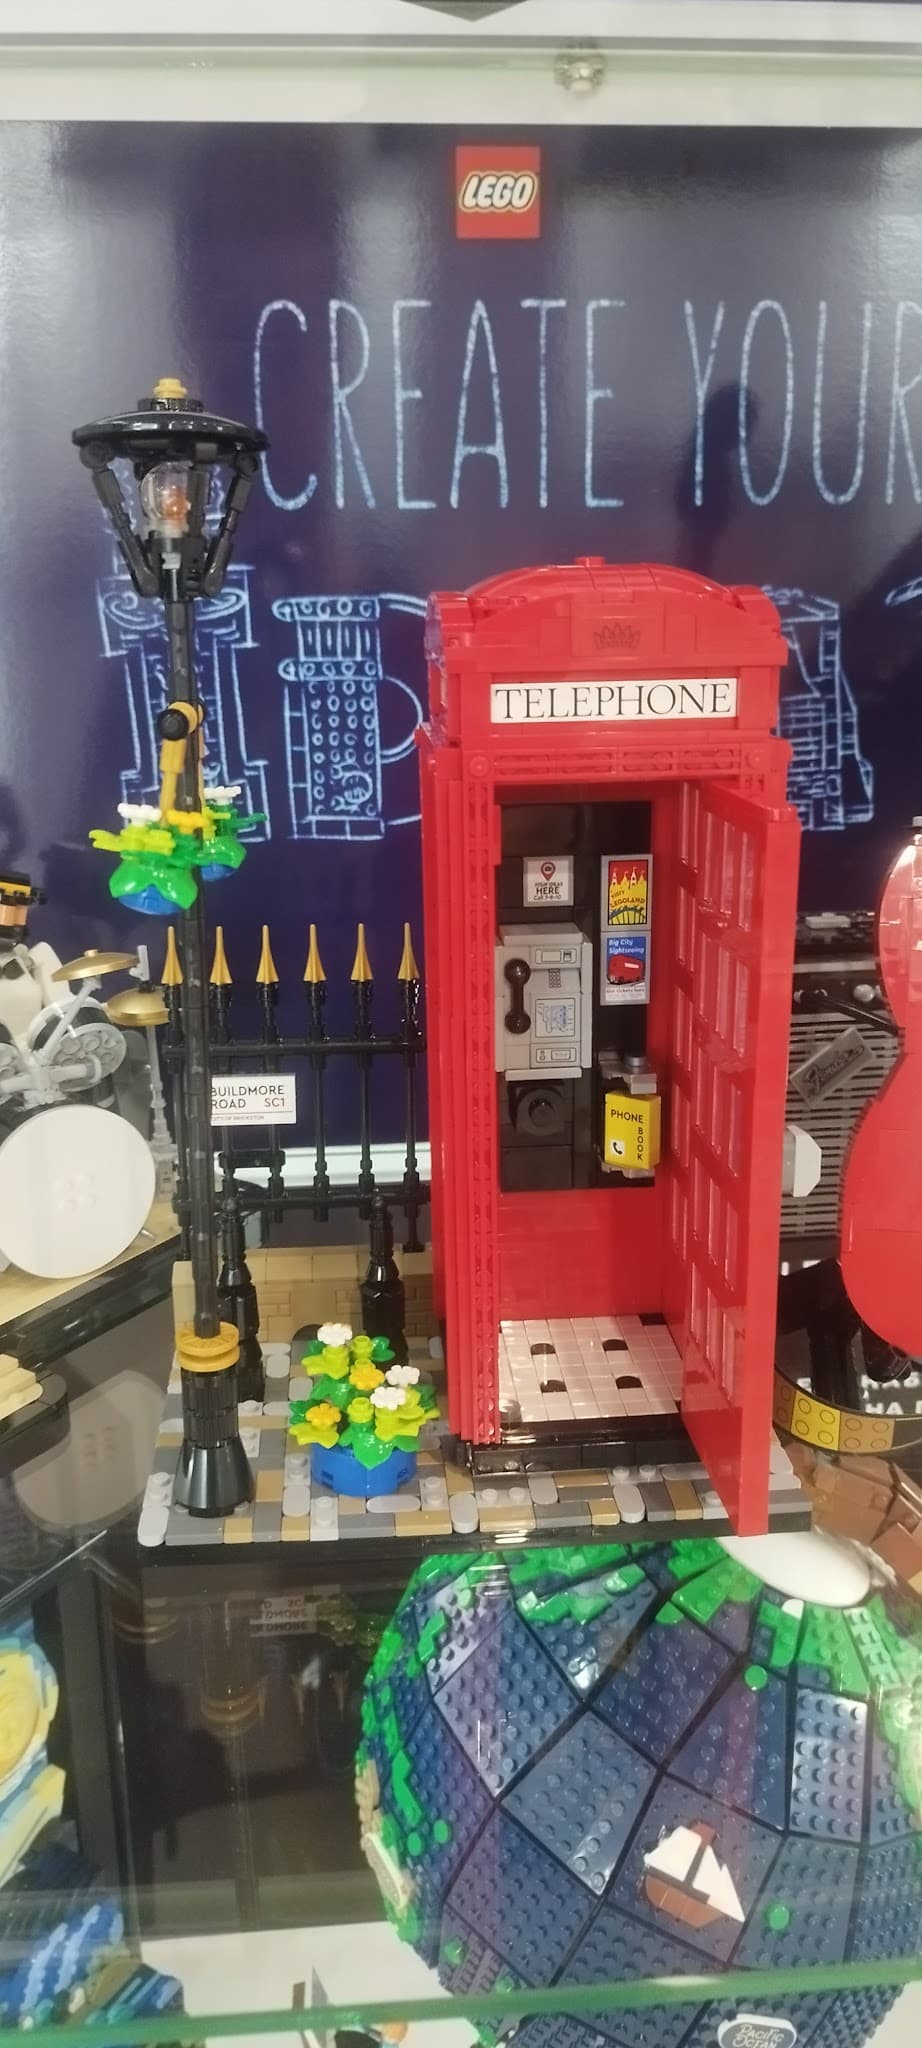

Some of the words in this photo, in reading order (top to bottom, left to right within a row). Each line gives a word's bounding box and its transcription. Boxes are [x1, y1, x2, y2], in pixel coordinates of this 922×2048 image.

[461, 173, 536, 211] LEGO
[254, 300, 626, 511] CREATE
[684, 299, 922, 506] YOUR
[495, 683, 732, 719] TELEPHONE
[536, 887, 560, 895] HERE
[610, 897, 646, 908] LEGOLAND
[608, 938, 619, 946] Big
[620, 938, 634, 946] City
[211, 1085, 285, 1097] BUILDMORE
[211, 1098, 247, 1109] ROAD
[264, 1097, 285, 1108] SC1
[611, 1108, 645, 1123] PHONE
[637, 1126, 645, 1161] BOOK
[739, 2023, 785, 2042] PACIFIC
[732, 2033, 778, 2048] OCEAN
